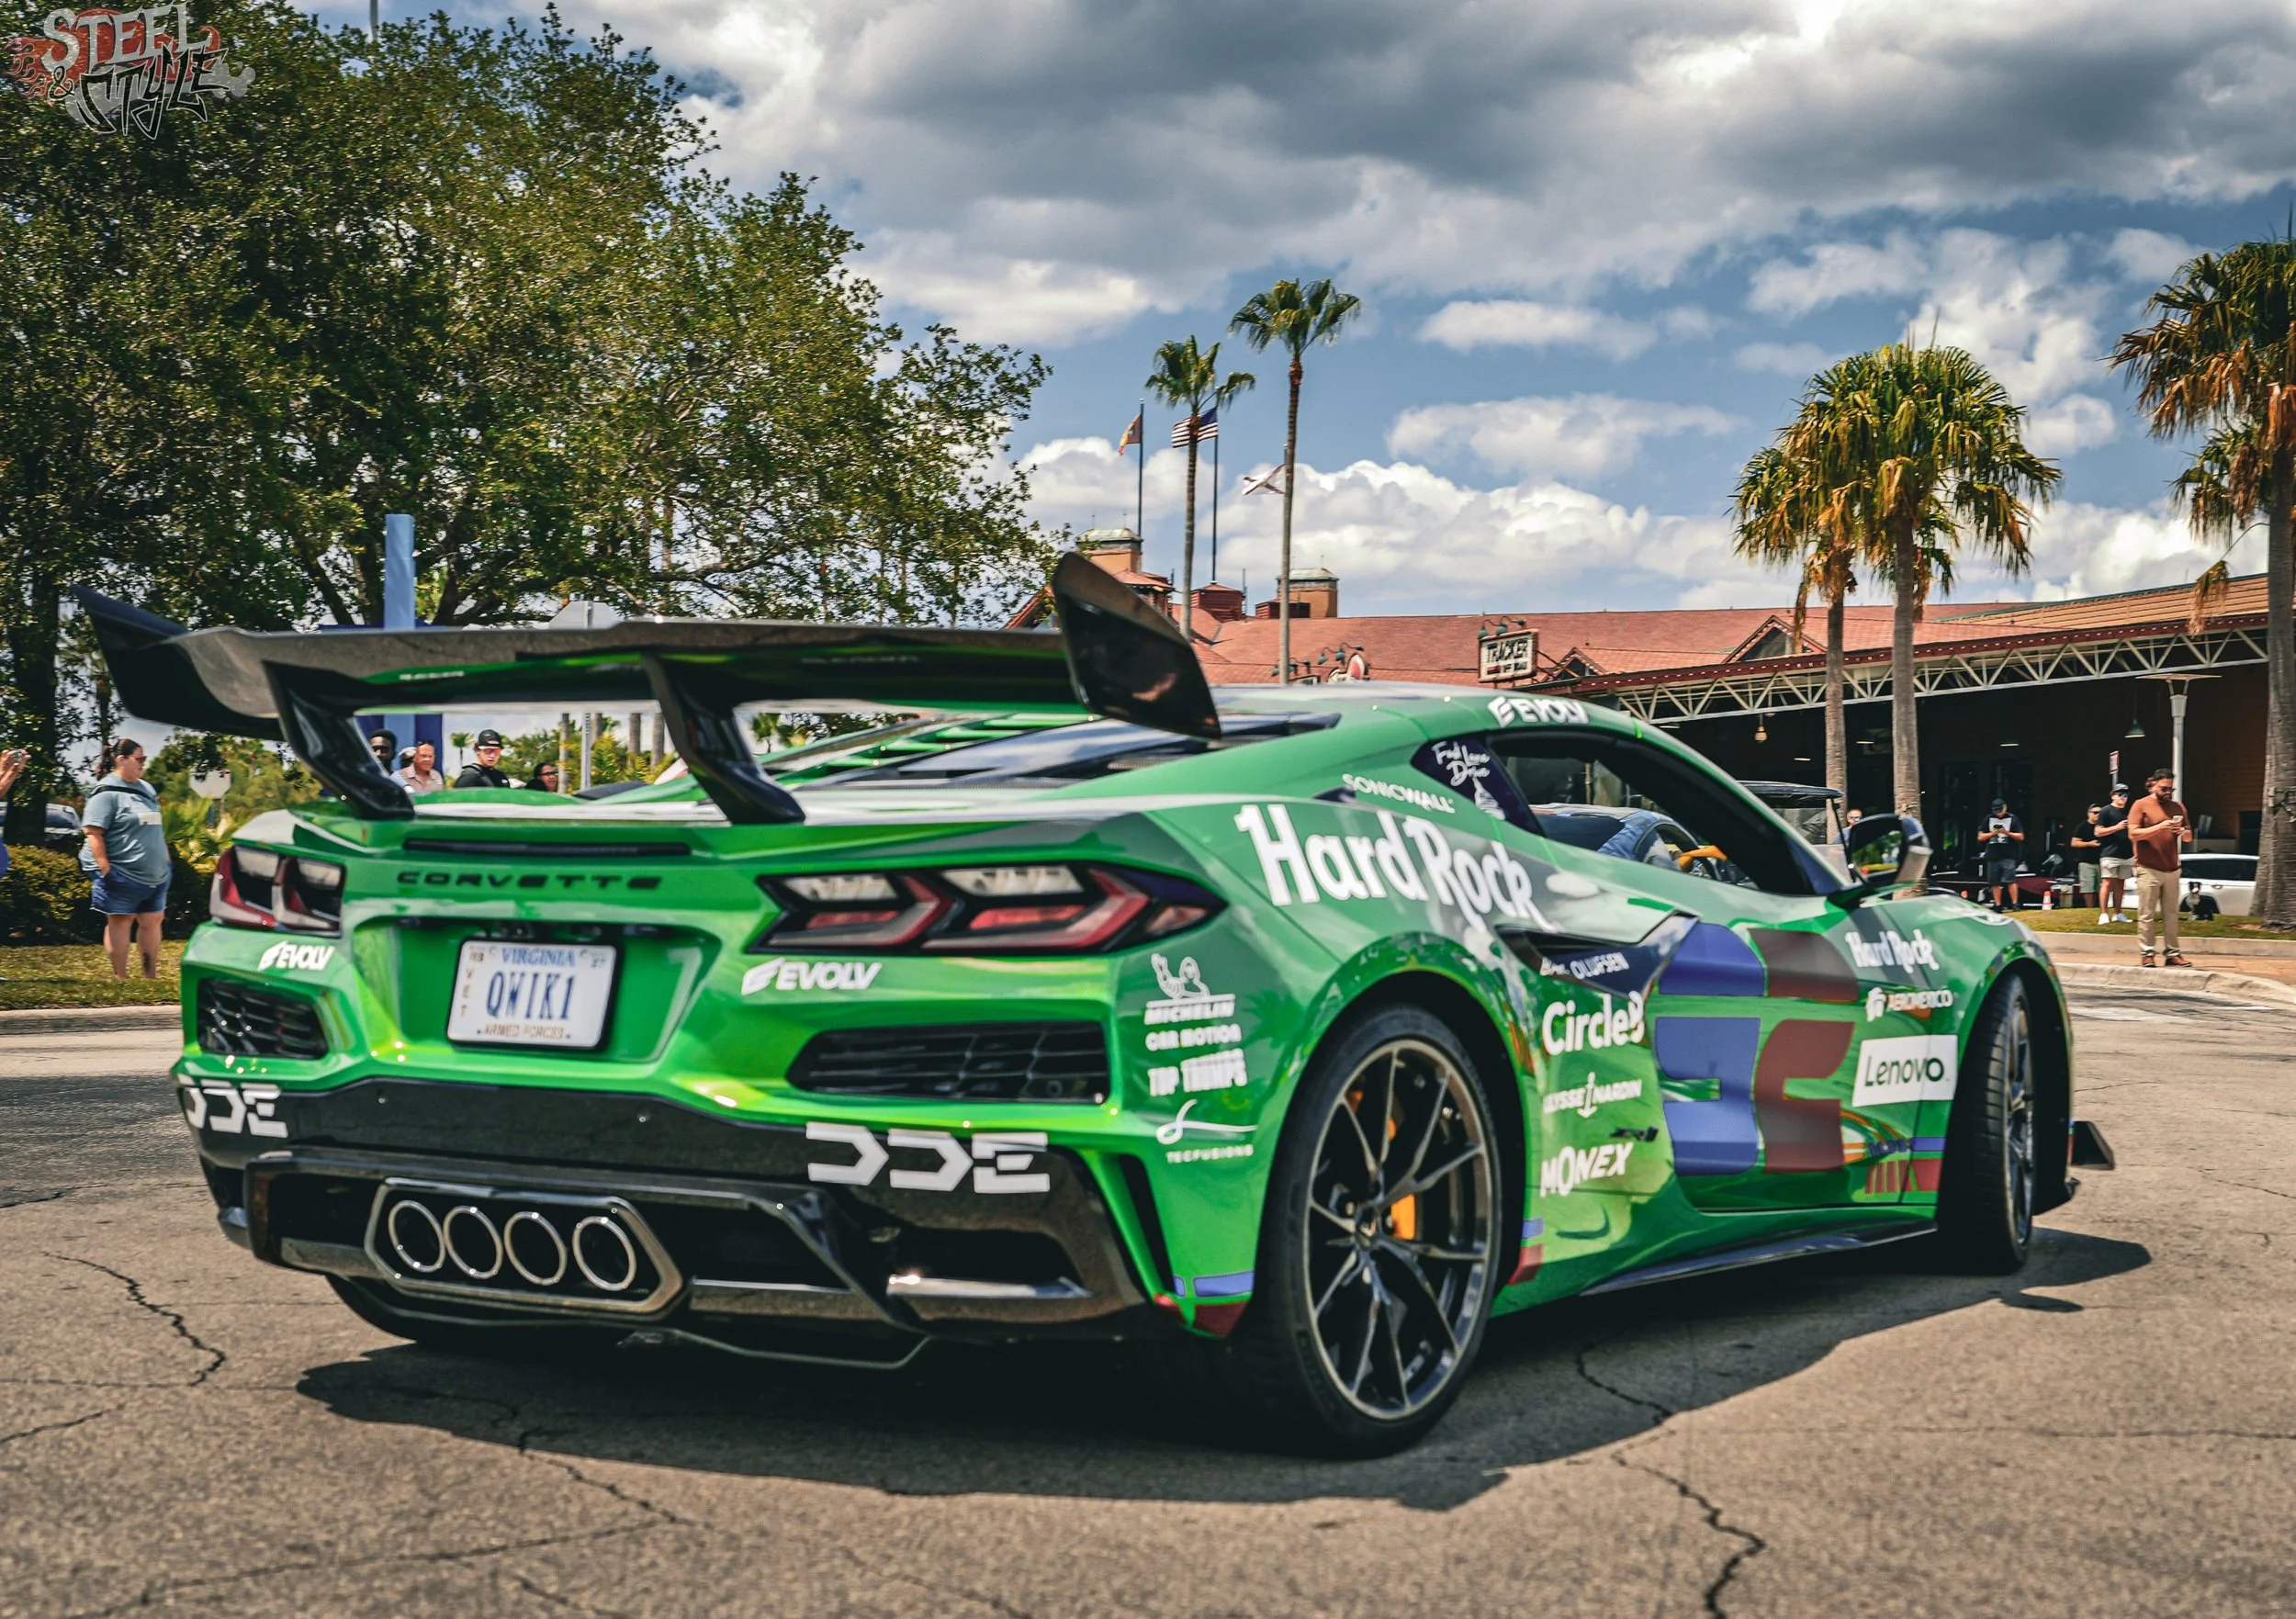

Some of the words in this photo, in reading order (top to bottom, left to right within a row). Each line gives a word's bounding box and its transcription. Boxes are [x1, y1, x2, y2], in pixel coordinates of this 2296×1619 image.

[396, 871, 661, 891] CORVETTE
[1233, 804, 1429, 906] Hard
[1402, 815, 1561, 933] Rock
[276, 942, 335, 971] EVOLV
[501, 948, 575, 967] VIRGINIA
[1844, 930, 1894, 967] Hard
[775, 961, 883, 990] EVOLV
[1864, 1056, 1945, 1087] Lenovo
[1540, 1141, 1634, 1198] MONEX
